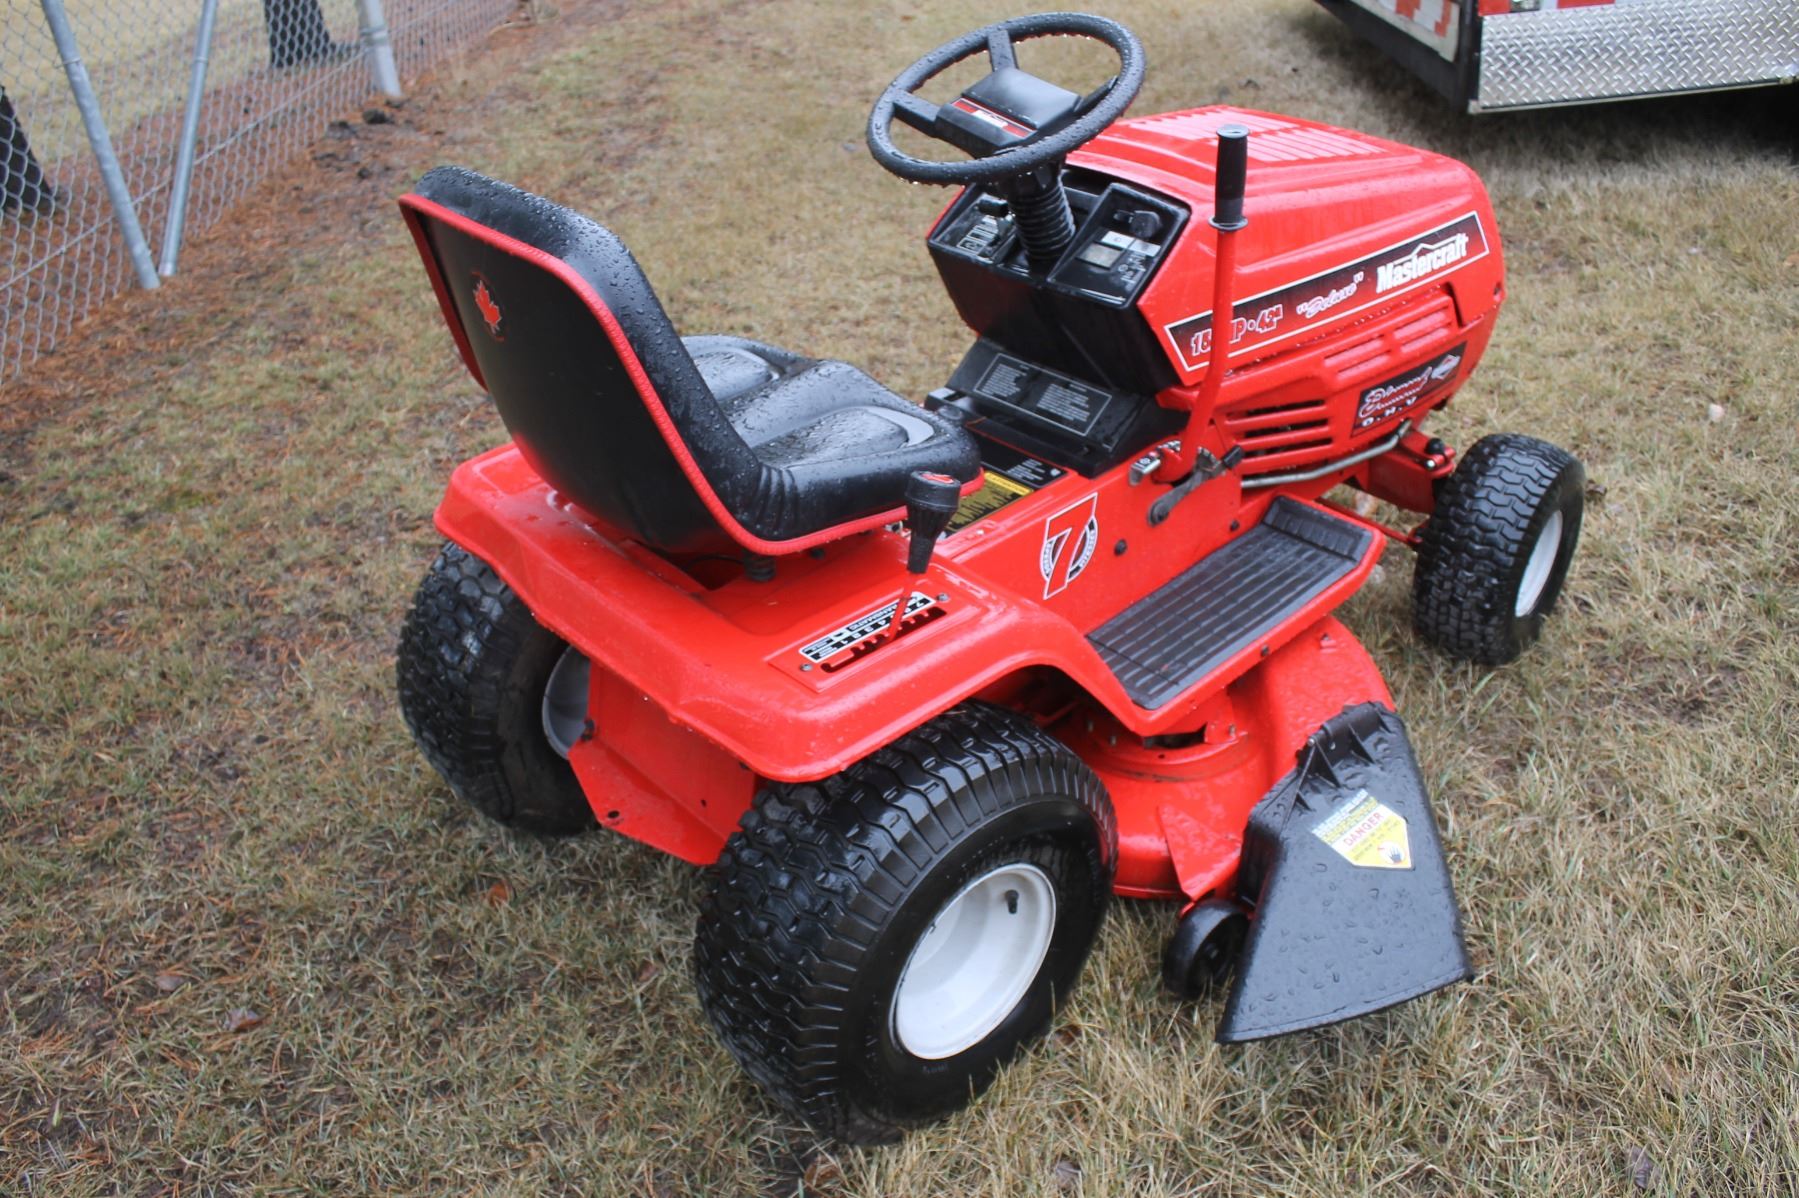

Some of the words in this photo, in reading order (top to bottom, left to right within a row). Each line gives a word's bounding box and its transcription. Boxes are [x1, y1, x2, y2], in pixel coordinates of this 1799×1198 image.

[1376, 233, 1469, 293] Mastercraft
[1043, 492, 1098, 600] 7
[1343, 811, 1384, 846] DANGER
